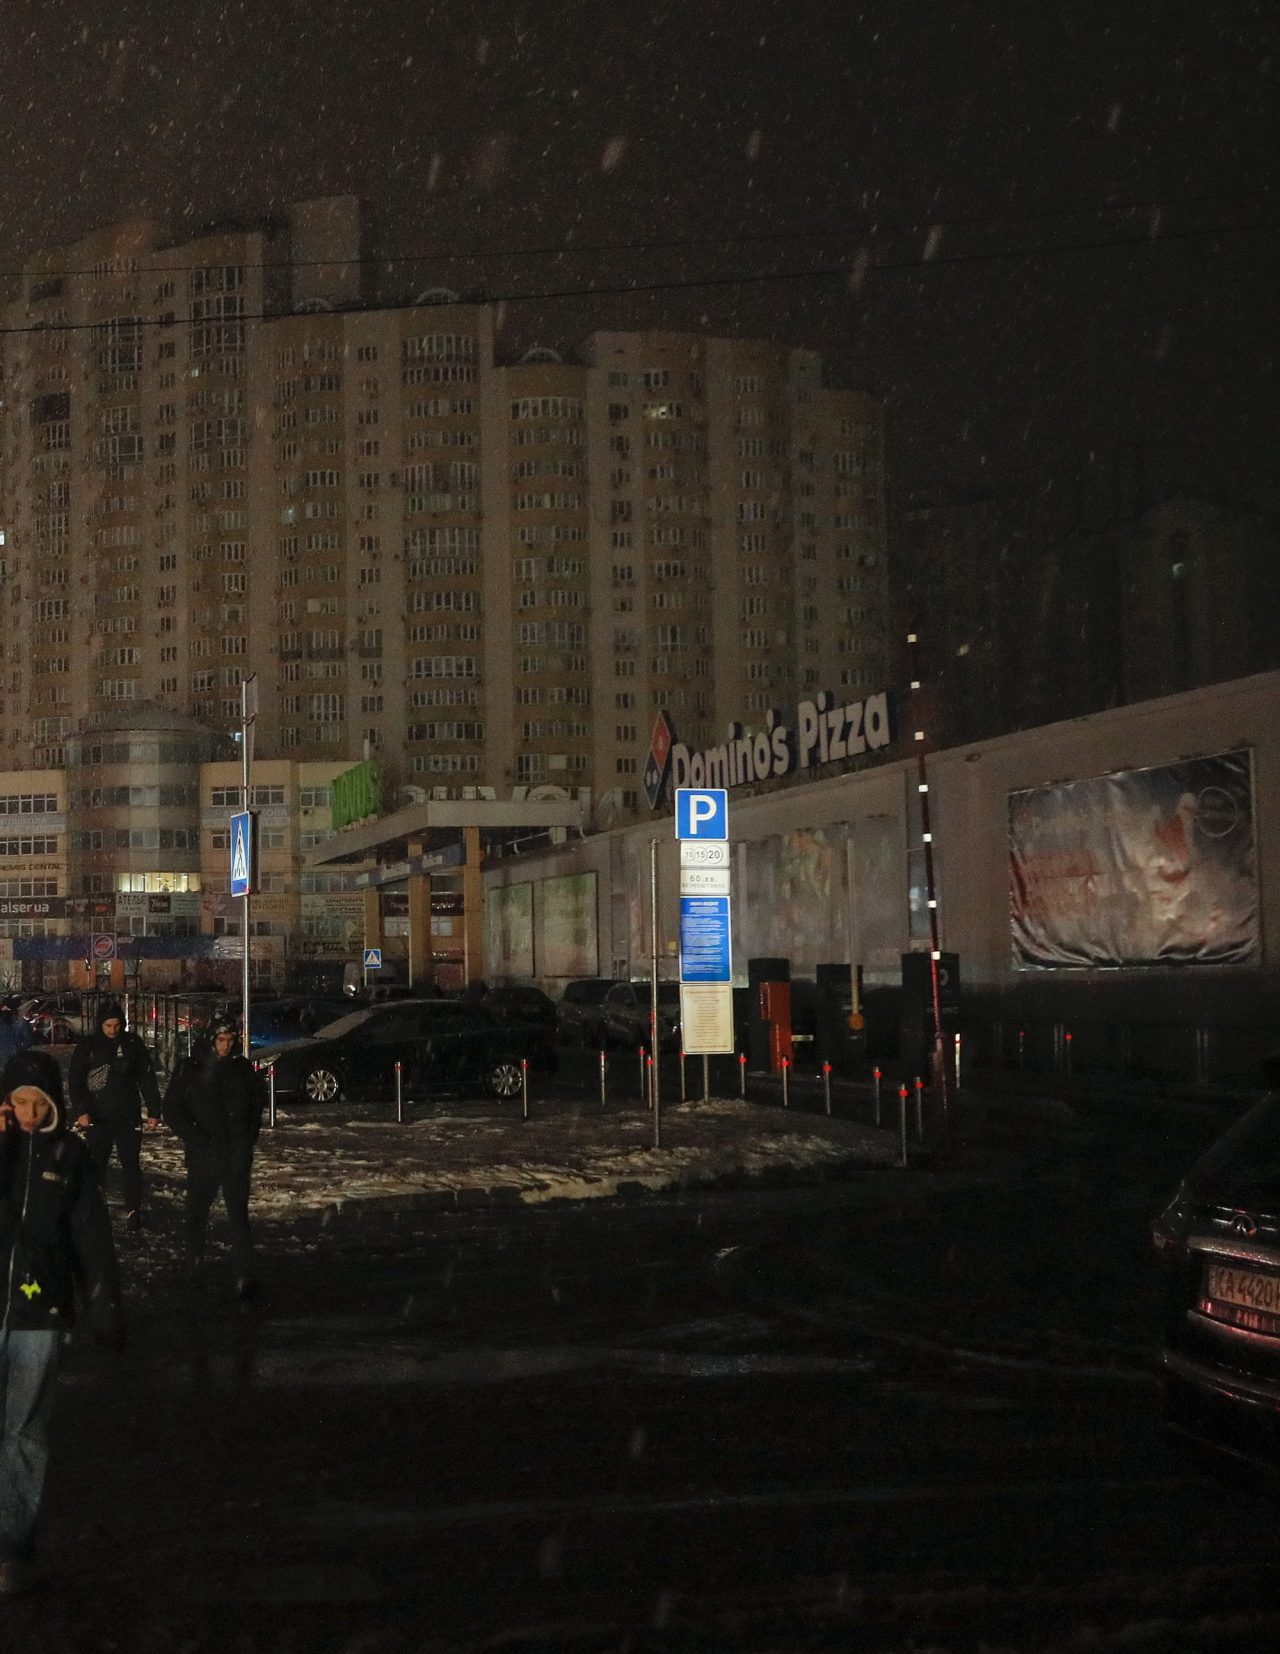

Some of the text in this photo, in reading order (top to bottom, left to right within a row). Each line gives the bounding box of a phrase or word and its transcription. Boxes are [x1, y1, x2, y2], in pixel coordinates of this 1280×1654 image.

[671, 691, 891, 789] Domino's Pizza
[689, 794, 717, 835] P
[696, 851, 706, 859] 15
[708, 850, 721, 859] 20
